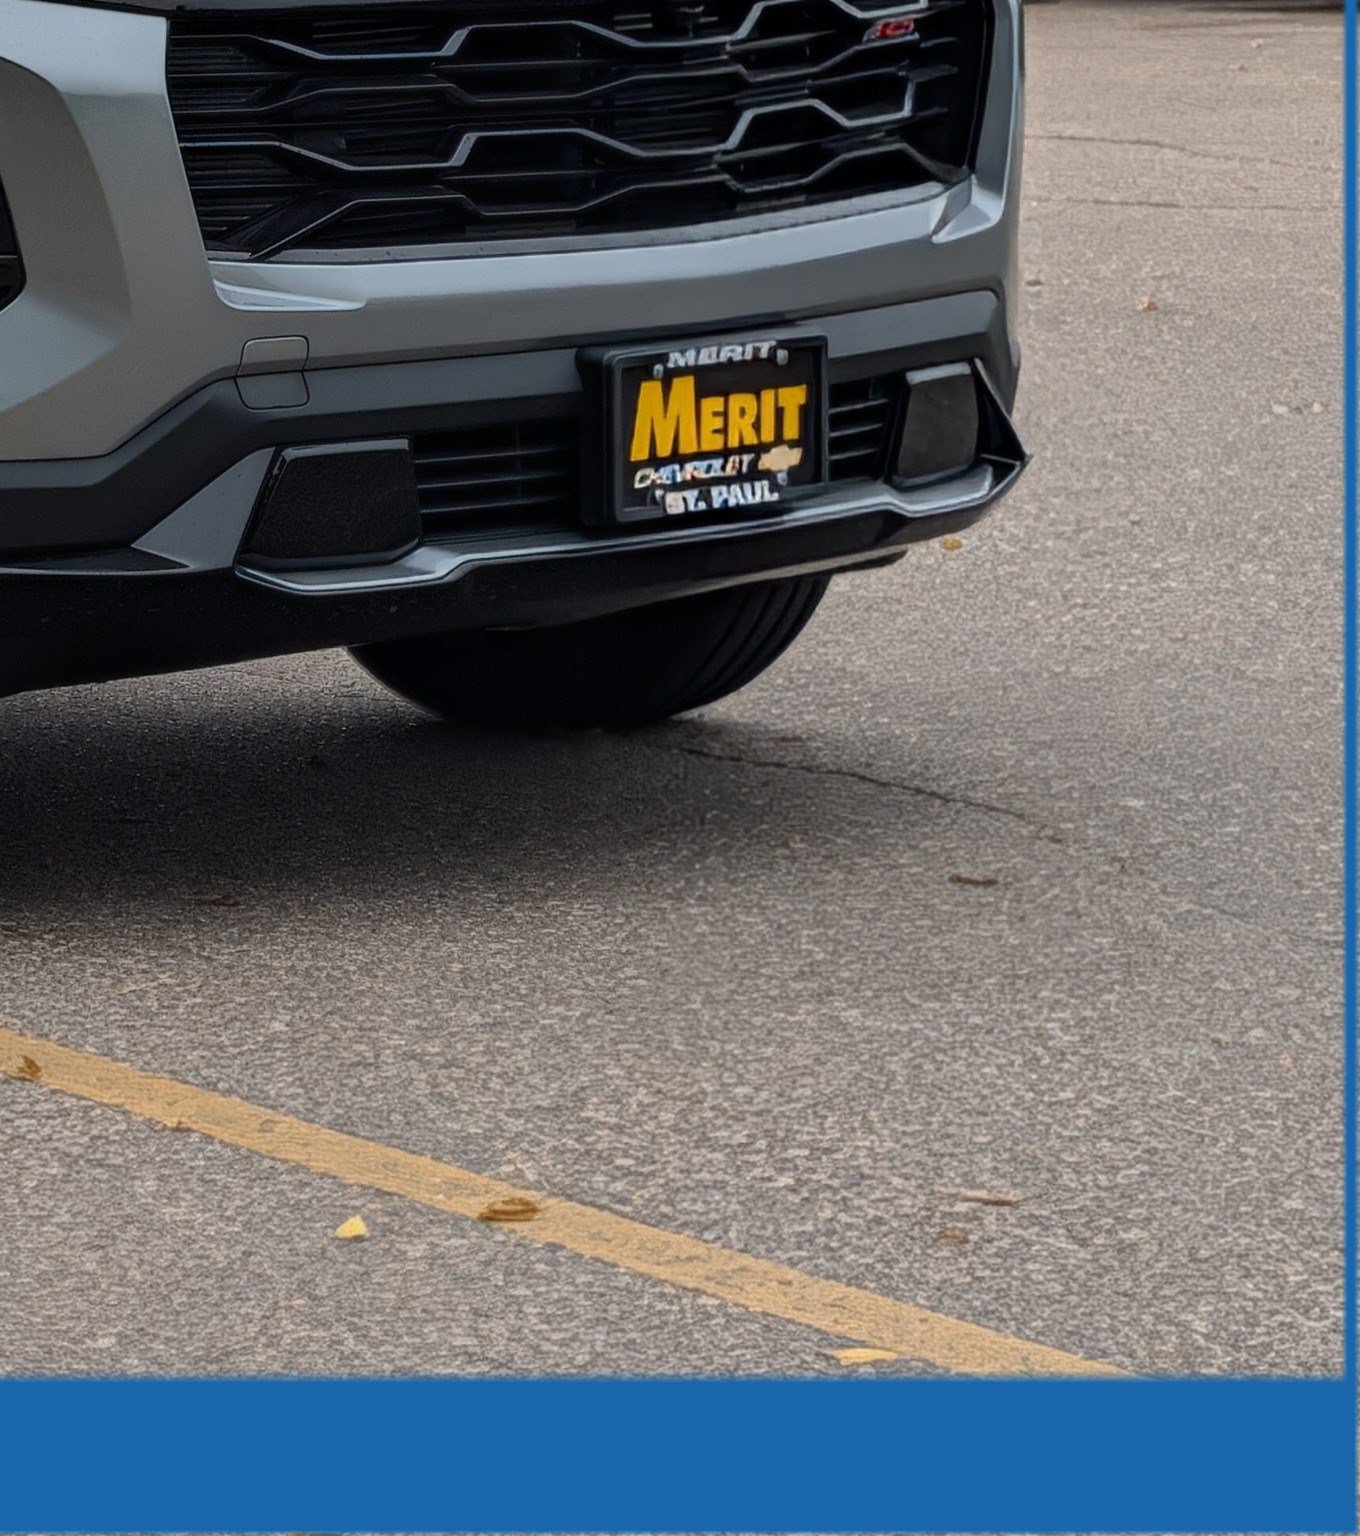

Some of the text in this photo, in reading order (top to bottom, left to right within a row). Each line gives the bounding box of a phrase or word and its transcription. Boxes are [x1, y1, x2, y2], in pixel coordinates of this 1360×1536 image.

[666, 340, 777, 368] MERIT
[630, 375, 808, 462] MERIT
[634, 452, 756, 490] CHEVROLET
[711, 480, 779, 507] PAUL
